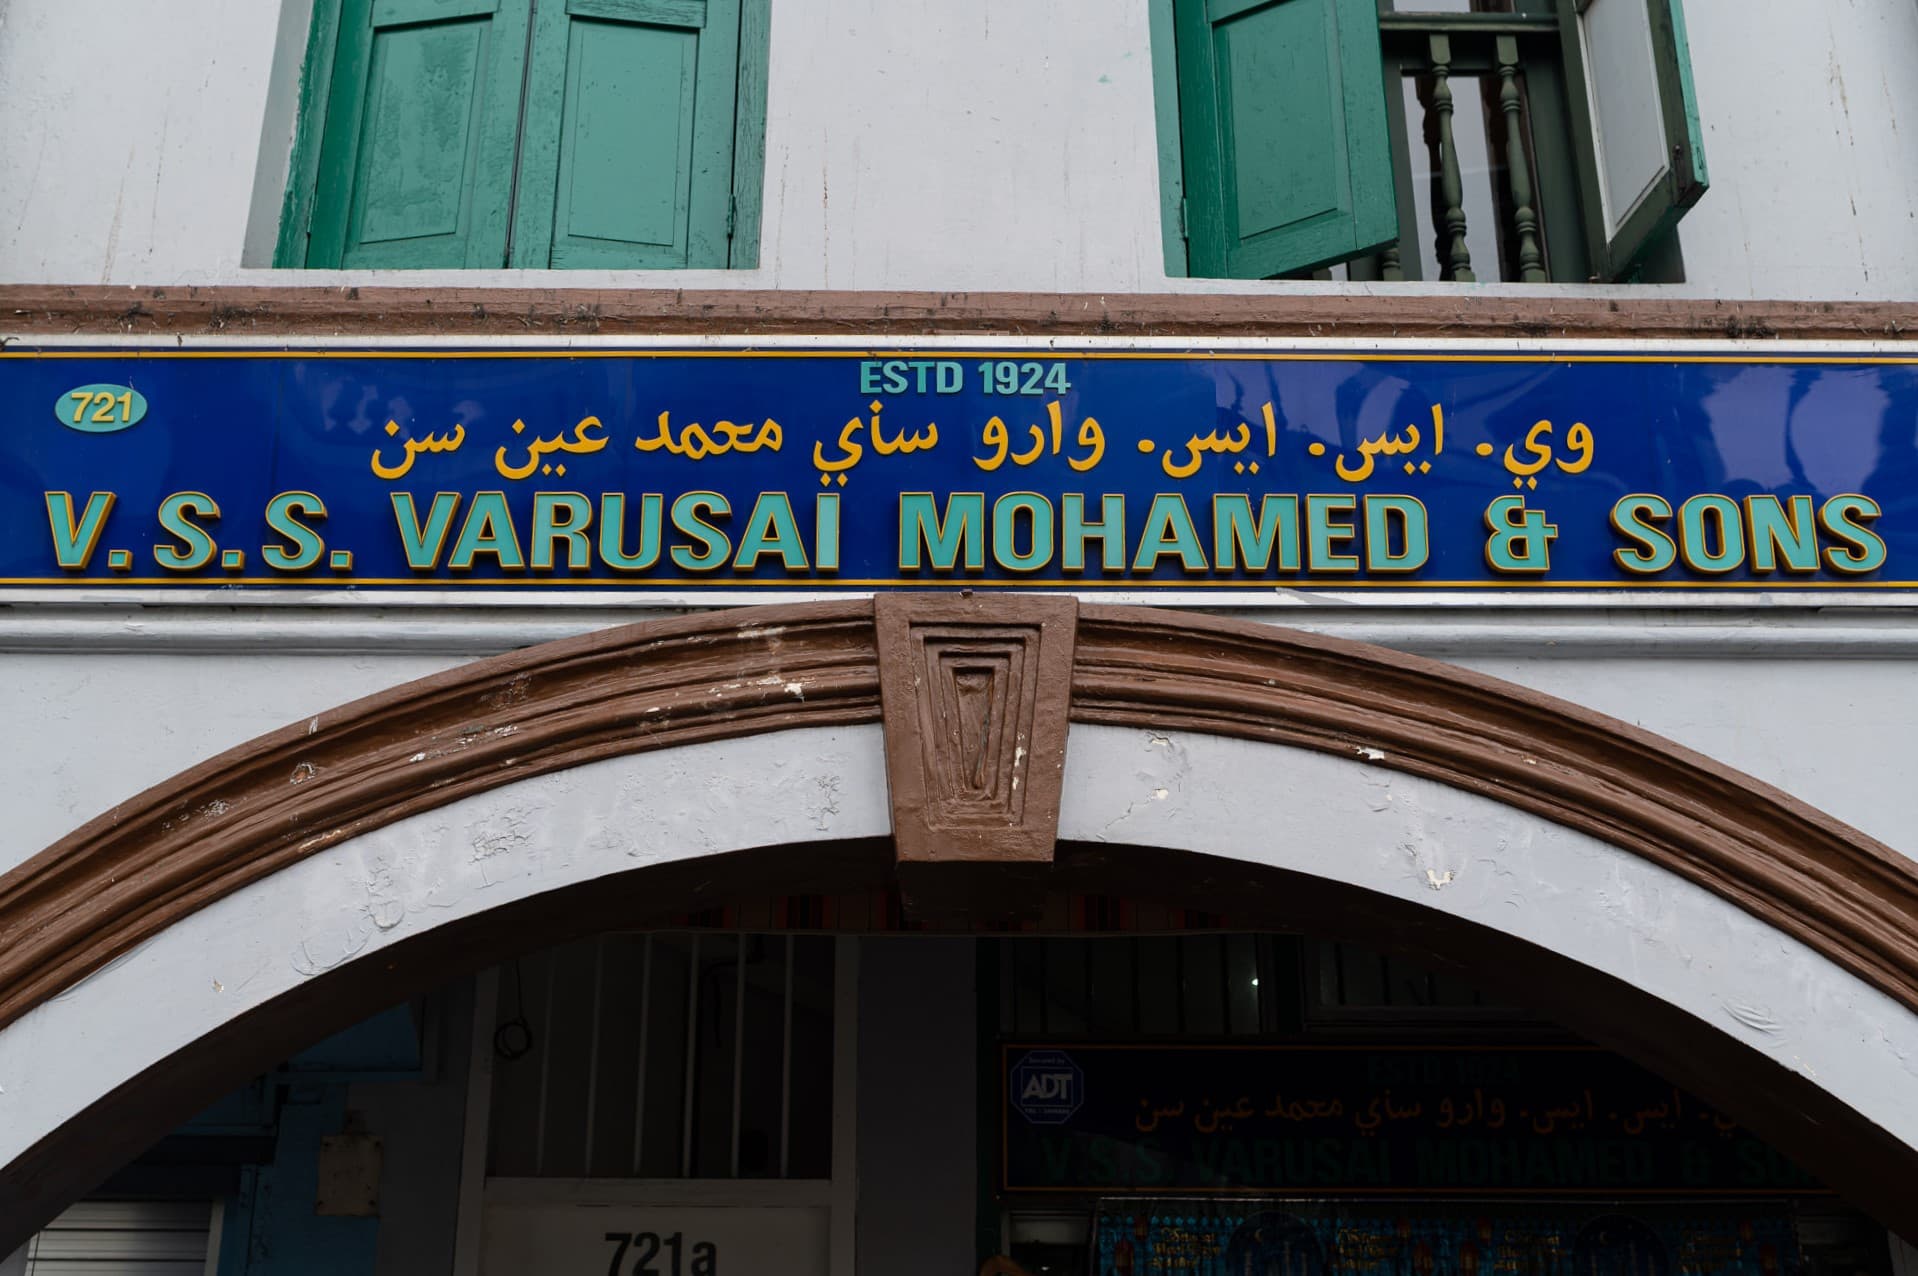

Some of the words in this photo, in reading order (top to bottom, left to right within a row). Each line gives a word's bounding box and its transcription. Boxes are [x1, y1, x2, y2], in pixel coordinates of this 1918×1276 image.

[860, 361, 964, 394] ESTD
[979, 361, 1071, 395] 1924
[72, 392, 132, 422] 721
[371, 419, 465, 480] سن
[495, 416, 609, 480] عين
[635, 411, 783, 459] محمد
[973, 401, 1105, 471] وارو
[390, 490, 841, 572] VARUSAI
[898, 491, 1430, 573] MOHAMED
[1484, 494, 1559, 573] &
[1611, 492, 1887, 574] SONS
[1022, 1072, 1073, 1100] ADT
[604, 1231, 718, 1276] 721a
